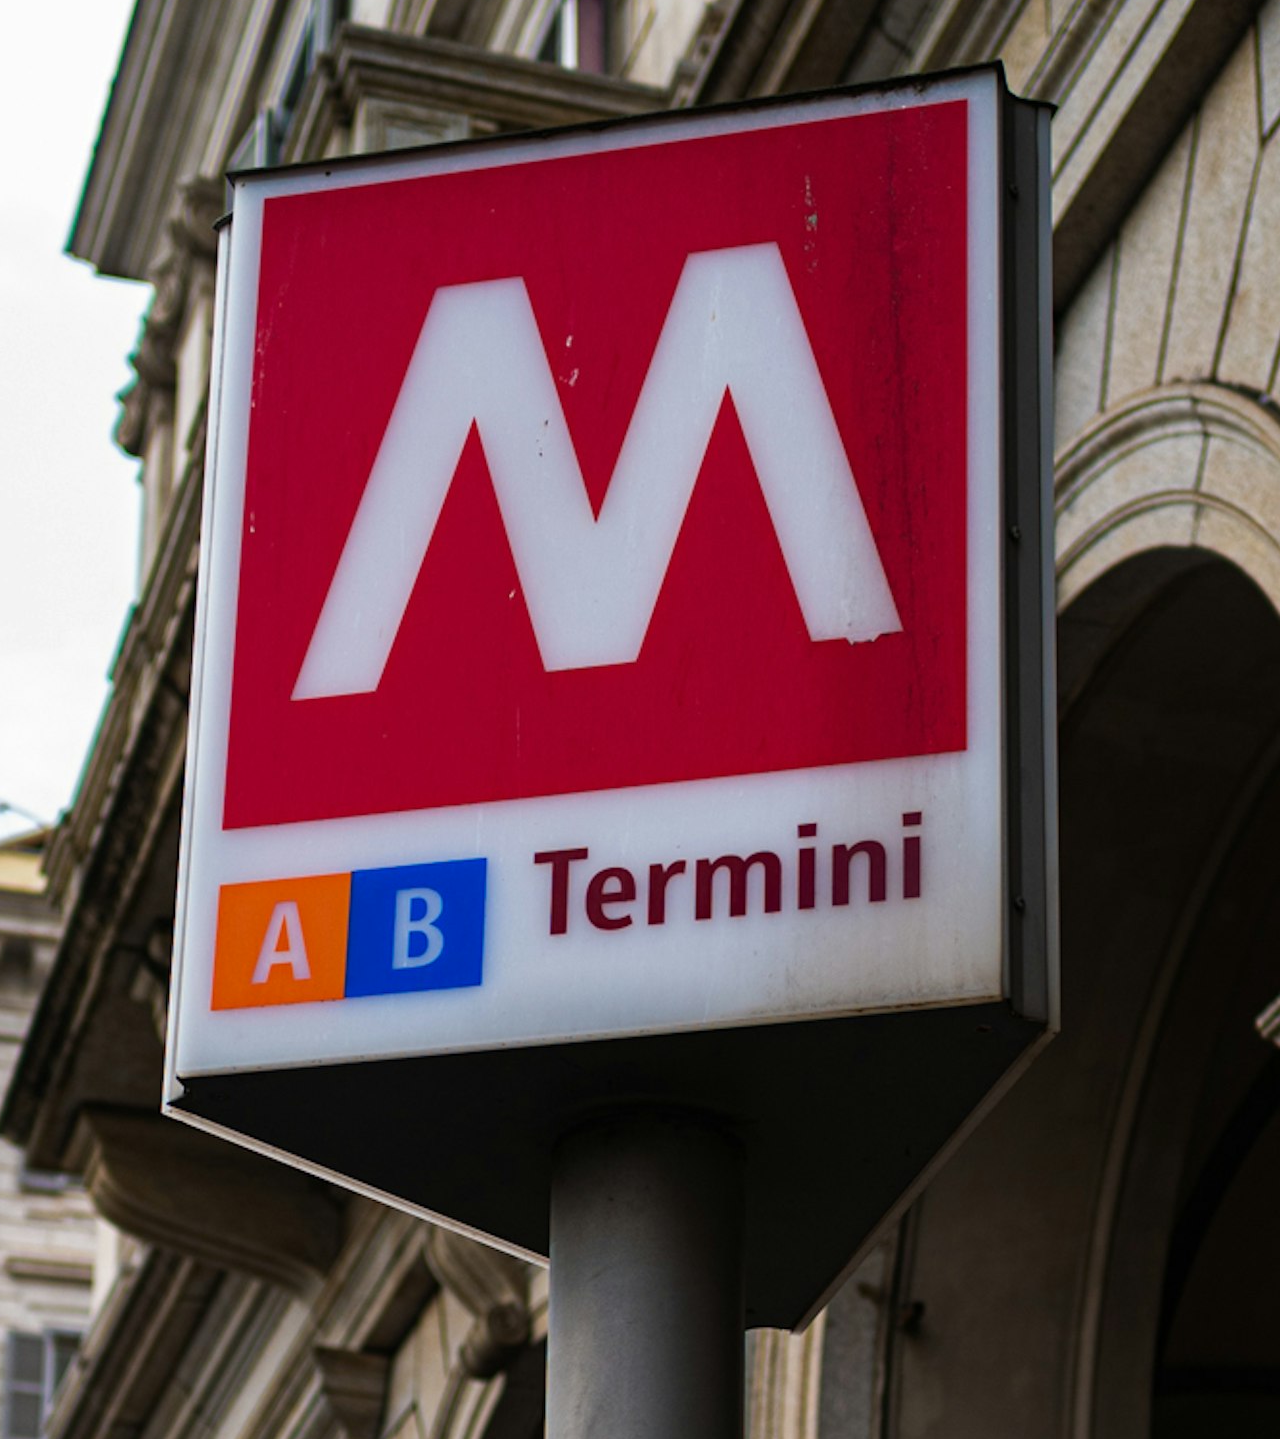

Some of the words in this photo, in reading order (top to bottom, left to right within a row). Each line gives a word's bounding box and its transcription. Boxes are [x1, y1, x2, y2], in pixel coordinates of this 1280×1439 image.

[290, 241, 904, 701] M
[251, 900, 312, 985] A
[391, 886, 444, 972] B
[533, 811, 923, 936] Termini
